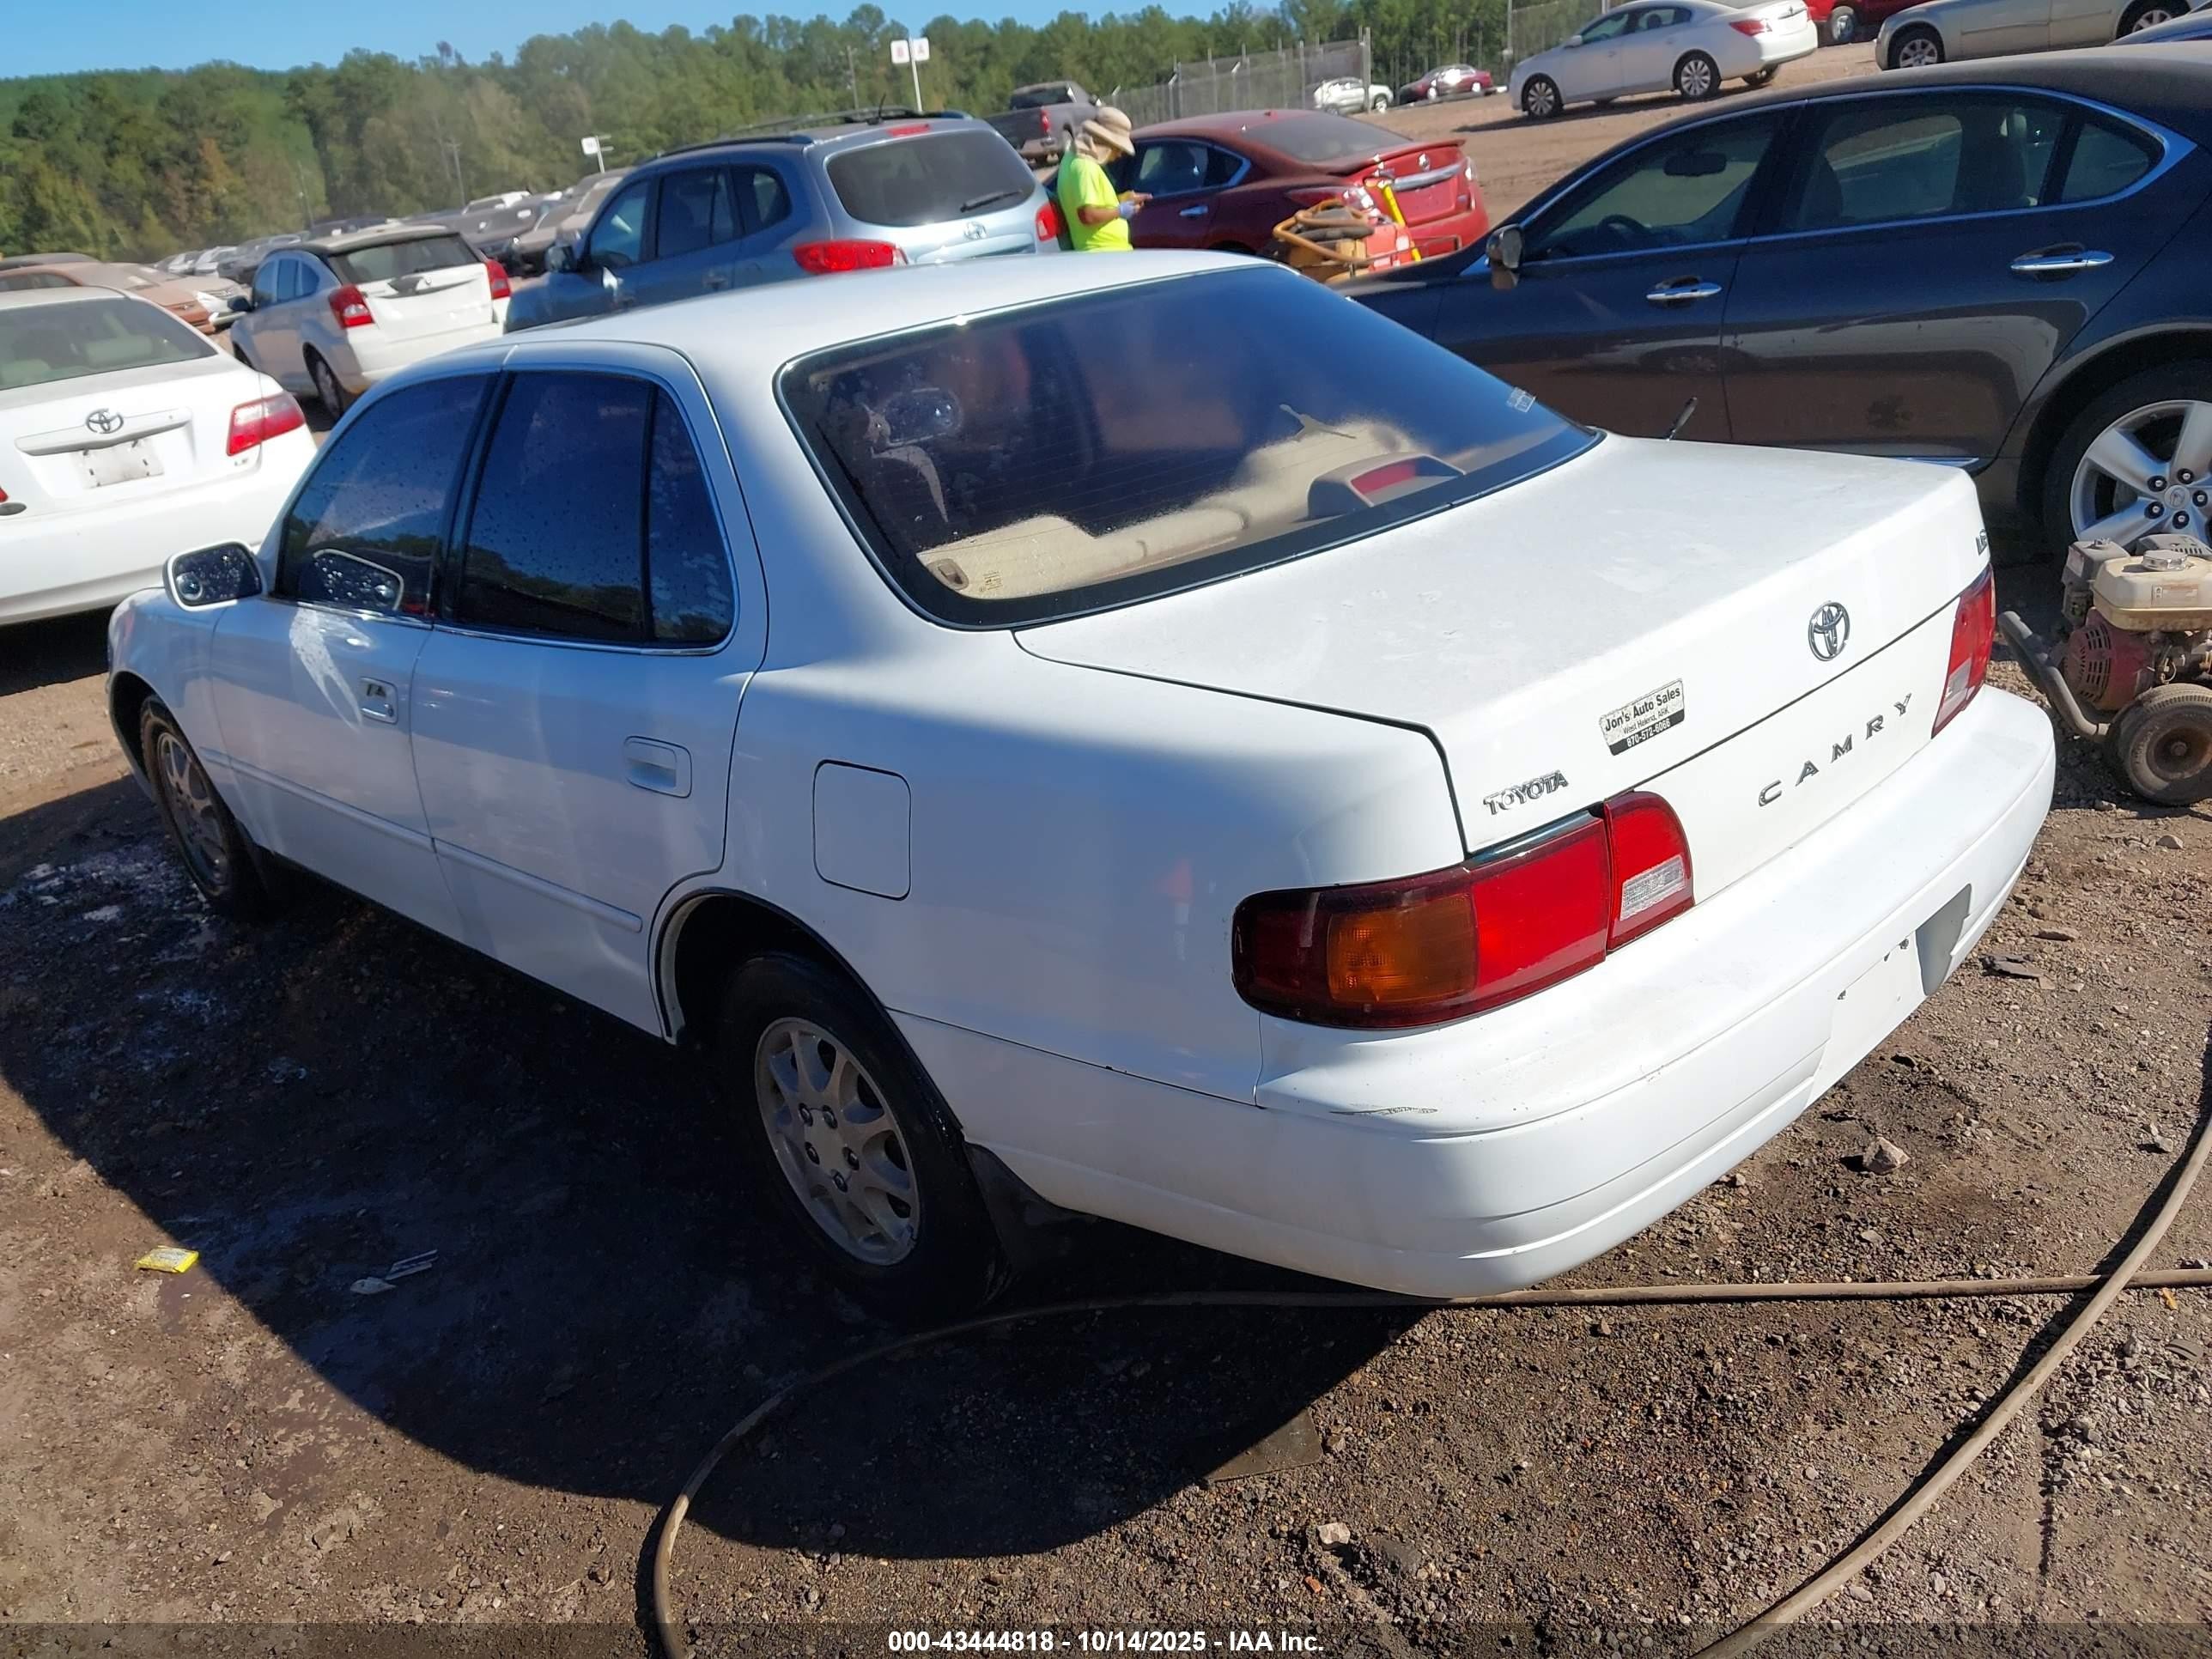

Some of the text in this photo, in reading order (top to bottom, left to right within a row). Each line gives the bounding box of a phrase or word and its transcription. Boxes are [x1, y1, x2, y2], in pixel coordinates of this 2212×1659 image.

[1605, 687, 1680, 732] Jon's Auto Sales
[1623, 724, 1637, 734] West
[1758, 692, 1913, 807] CAMRY
[1483, 769, 1569, 816] TOYOTA
